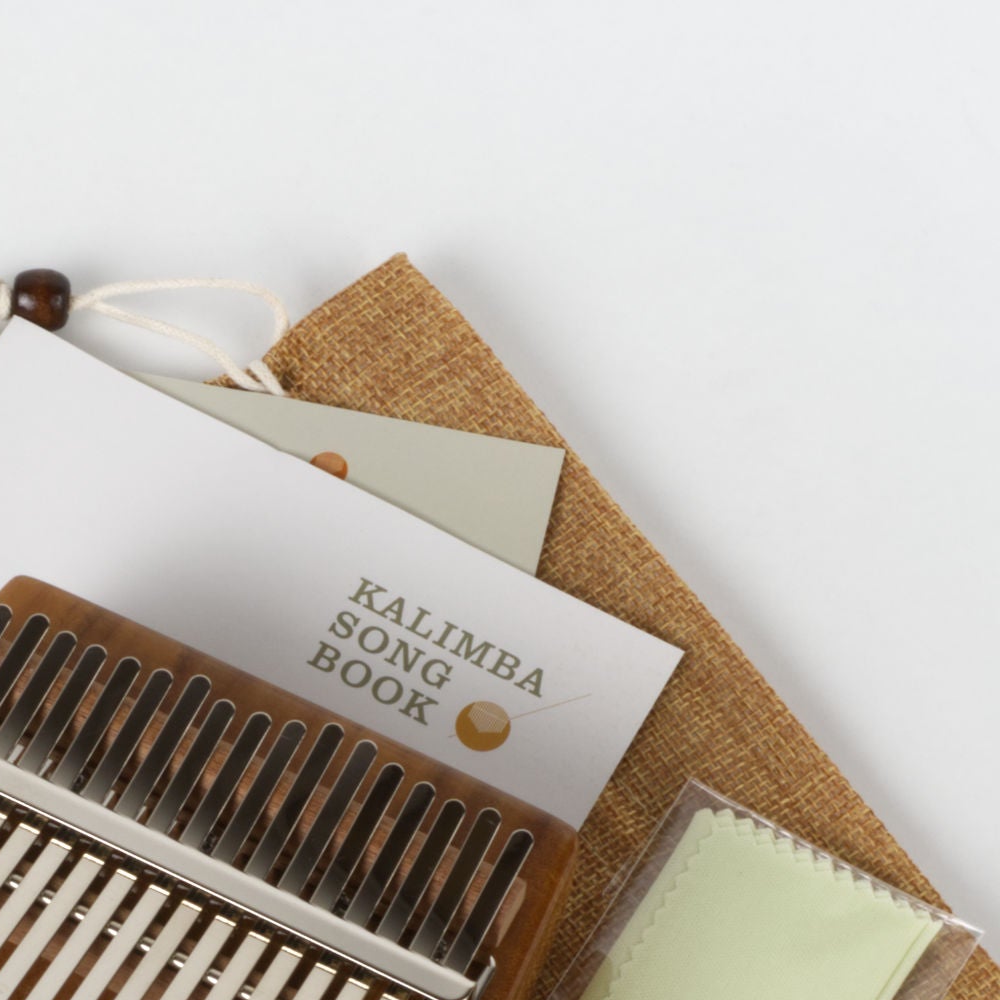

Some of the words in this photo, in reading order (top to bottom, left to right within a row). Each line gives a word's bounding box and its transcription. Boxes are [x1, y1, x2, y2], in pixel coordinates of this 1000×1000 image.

[328, 611, 453, 690] SONG
[348, 577, 545, 698] KALIMBA
[307, 641, 439, 726] BOOK
